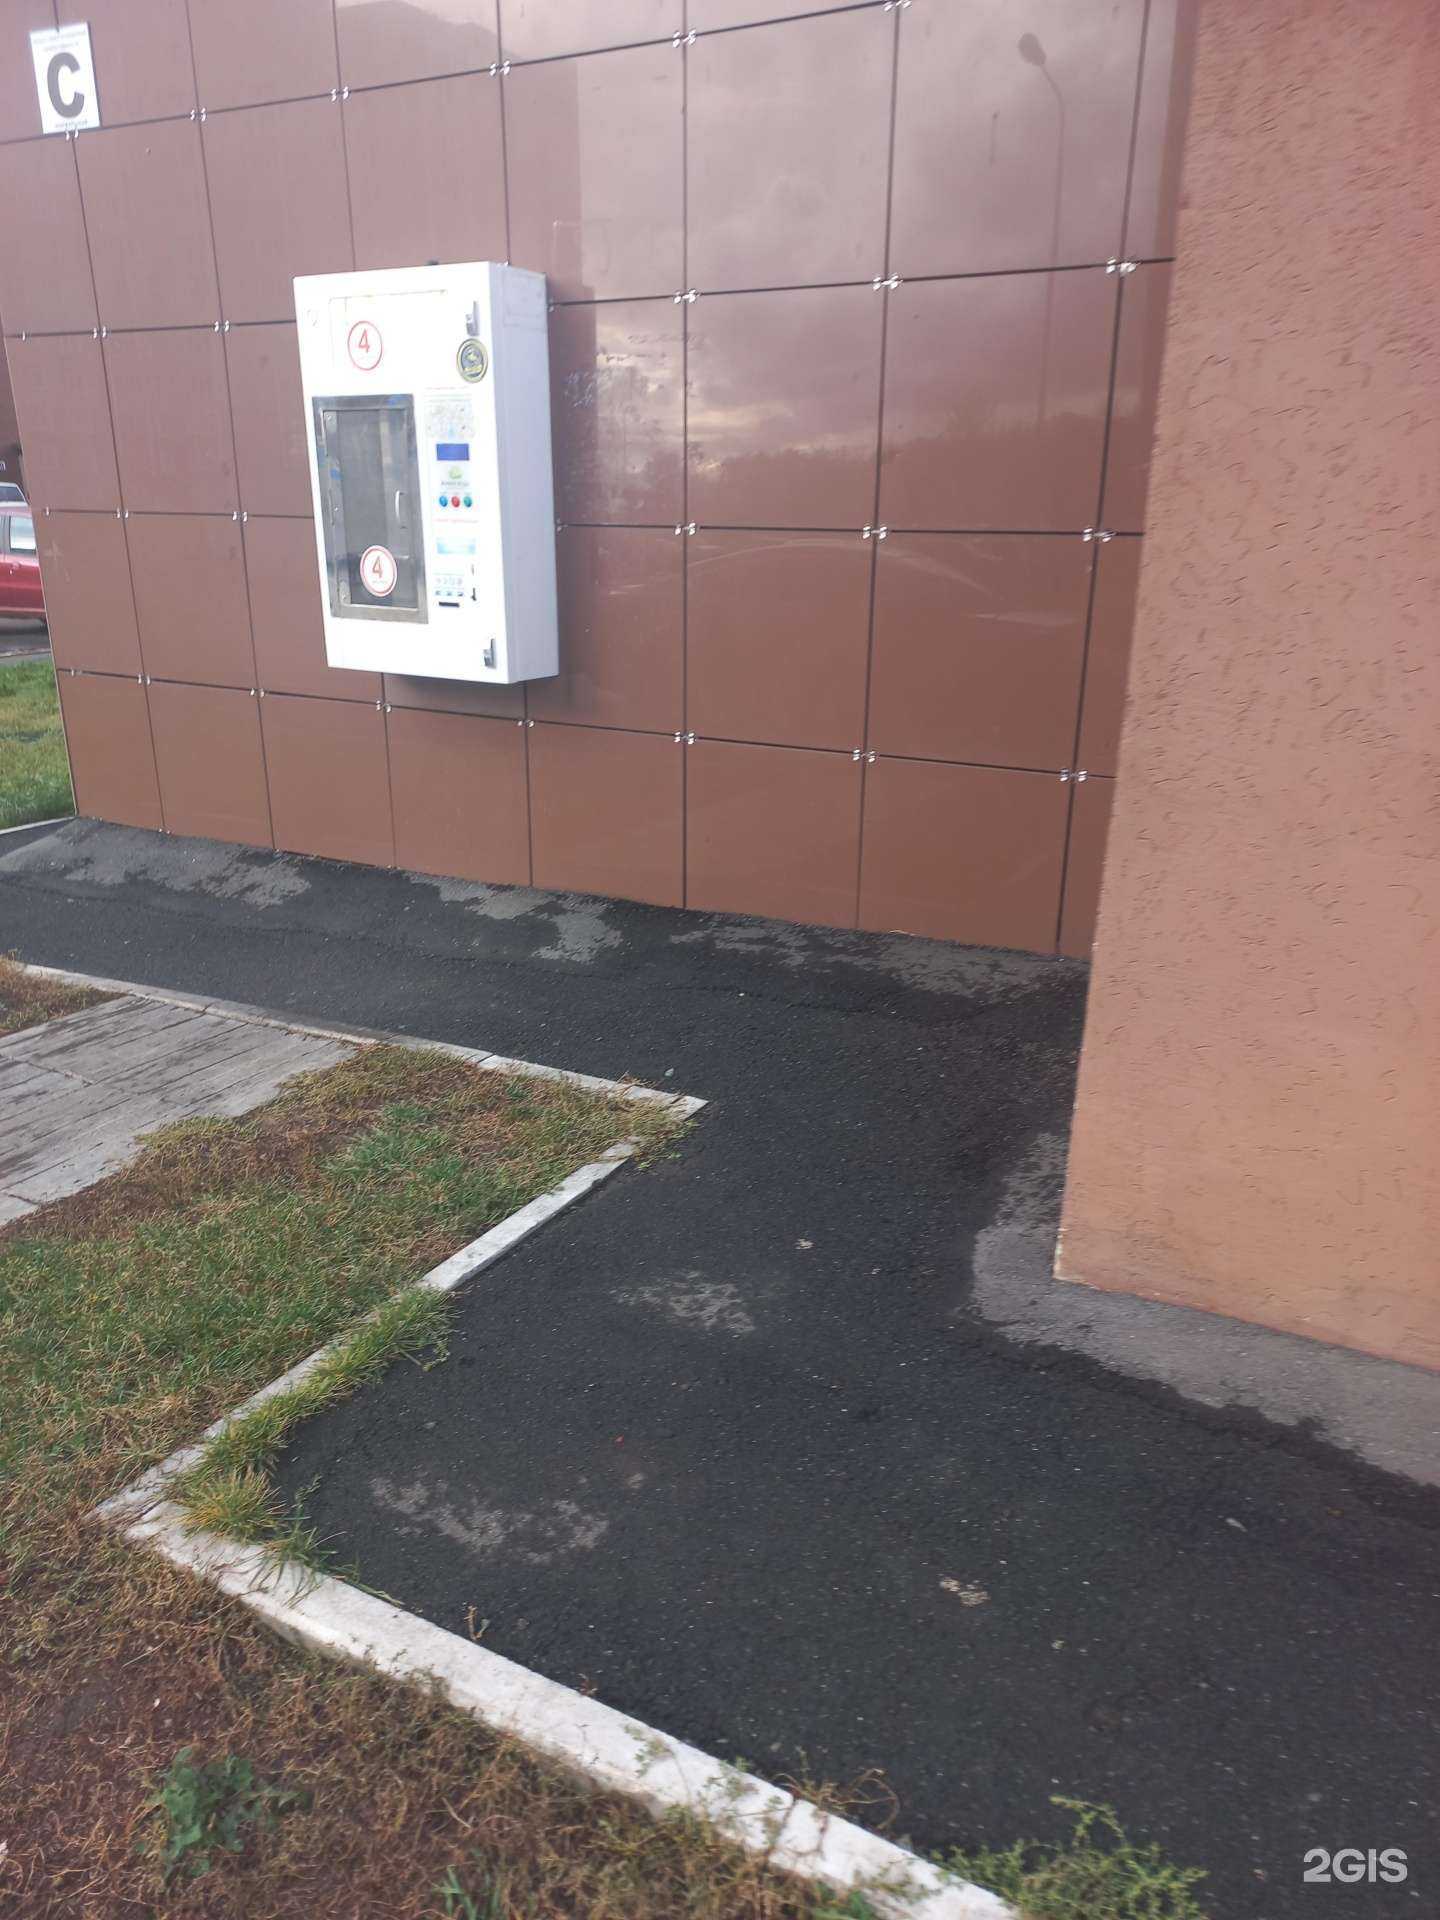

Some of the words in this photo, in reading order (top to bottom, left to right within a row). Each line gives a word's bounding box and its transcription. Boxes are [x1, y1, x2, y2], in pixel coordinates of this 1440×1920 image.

[46, 52, 85, 118] C
[358, 328, 370, 354] 4
[372, 555, 383, 578] 4
